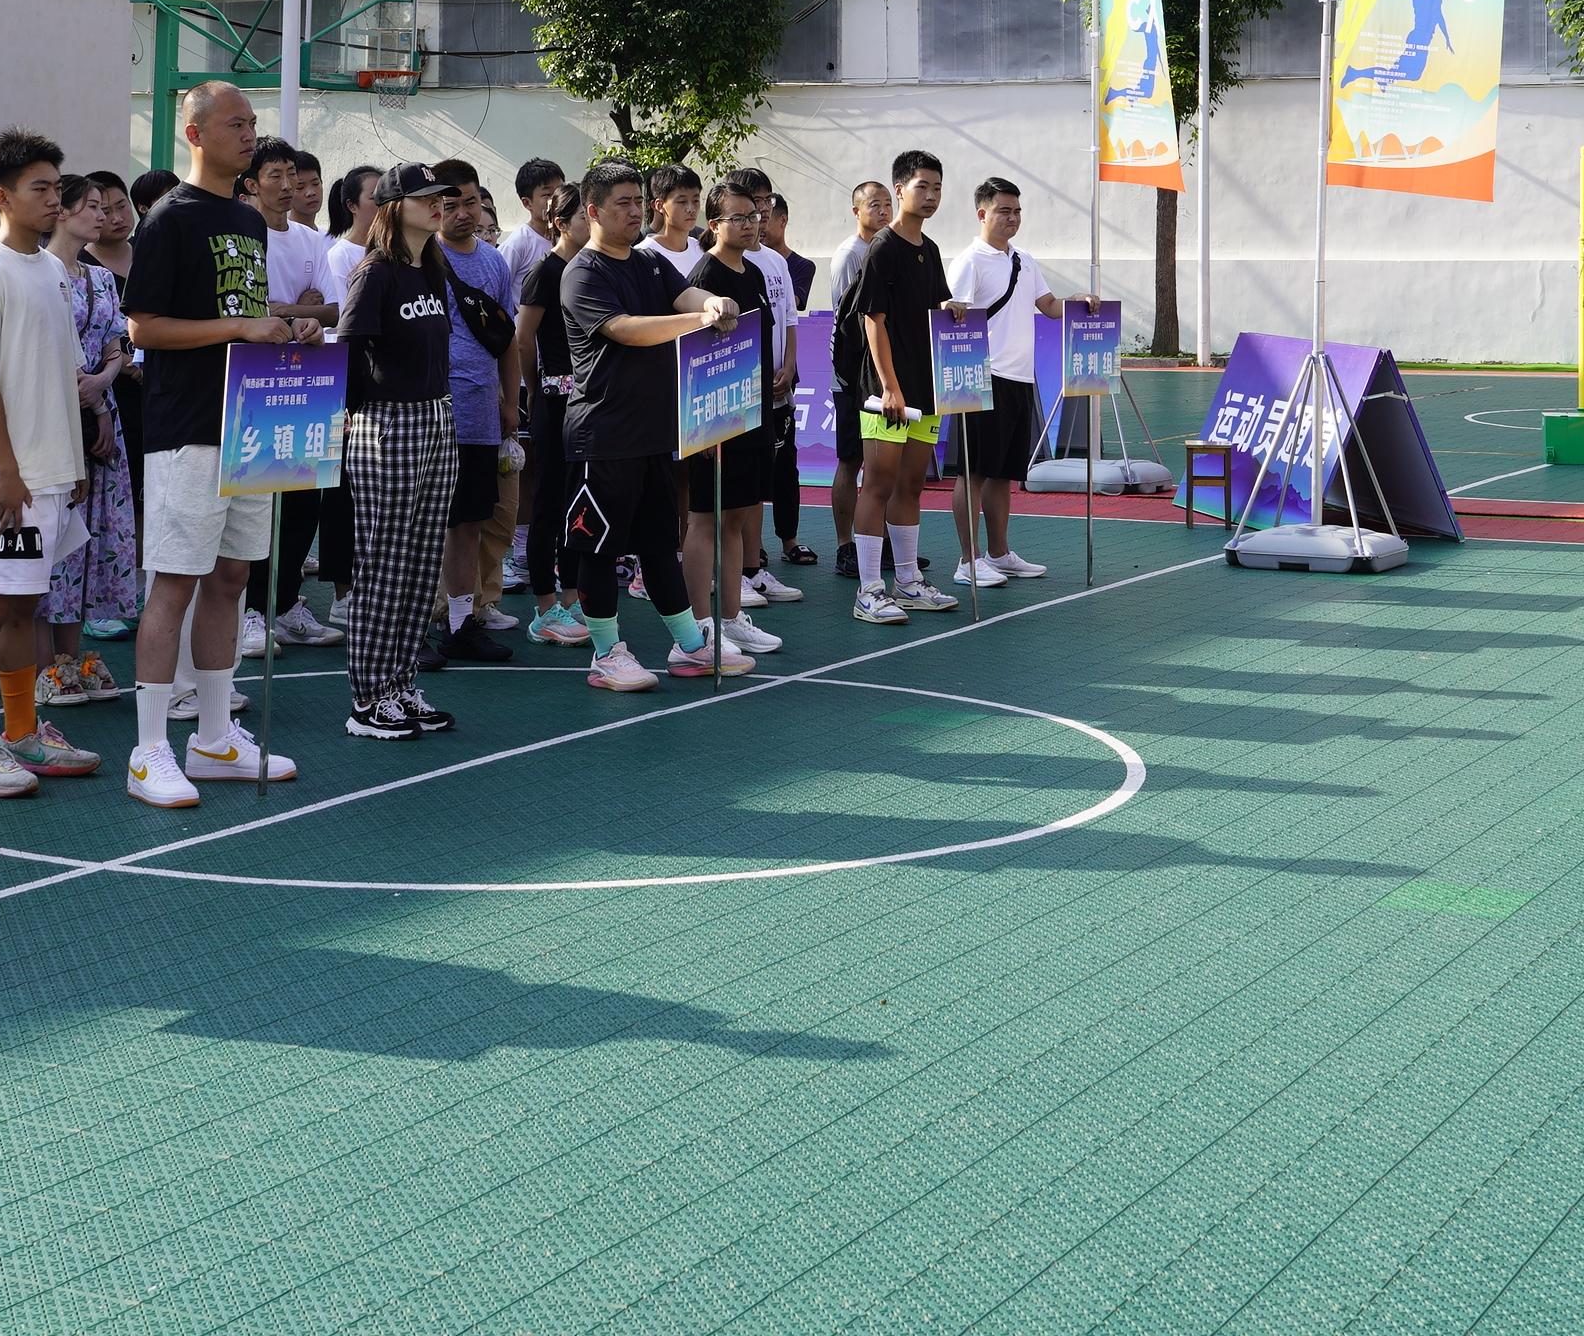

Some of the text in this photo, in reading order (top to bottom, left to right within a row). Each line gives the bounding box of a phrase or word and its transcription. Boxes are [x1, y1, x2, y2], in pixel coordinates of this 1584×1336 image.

[400, 293, 445, 320] adida
[943, 364, 984, 391] 青少年组
[692, 377, 752, 426] 干部职工组
[240, 422, 325, 463] 乡镇组
